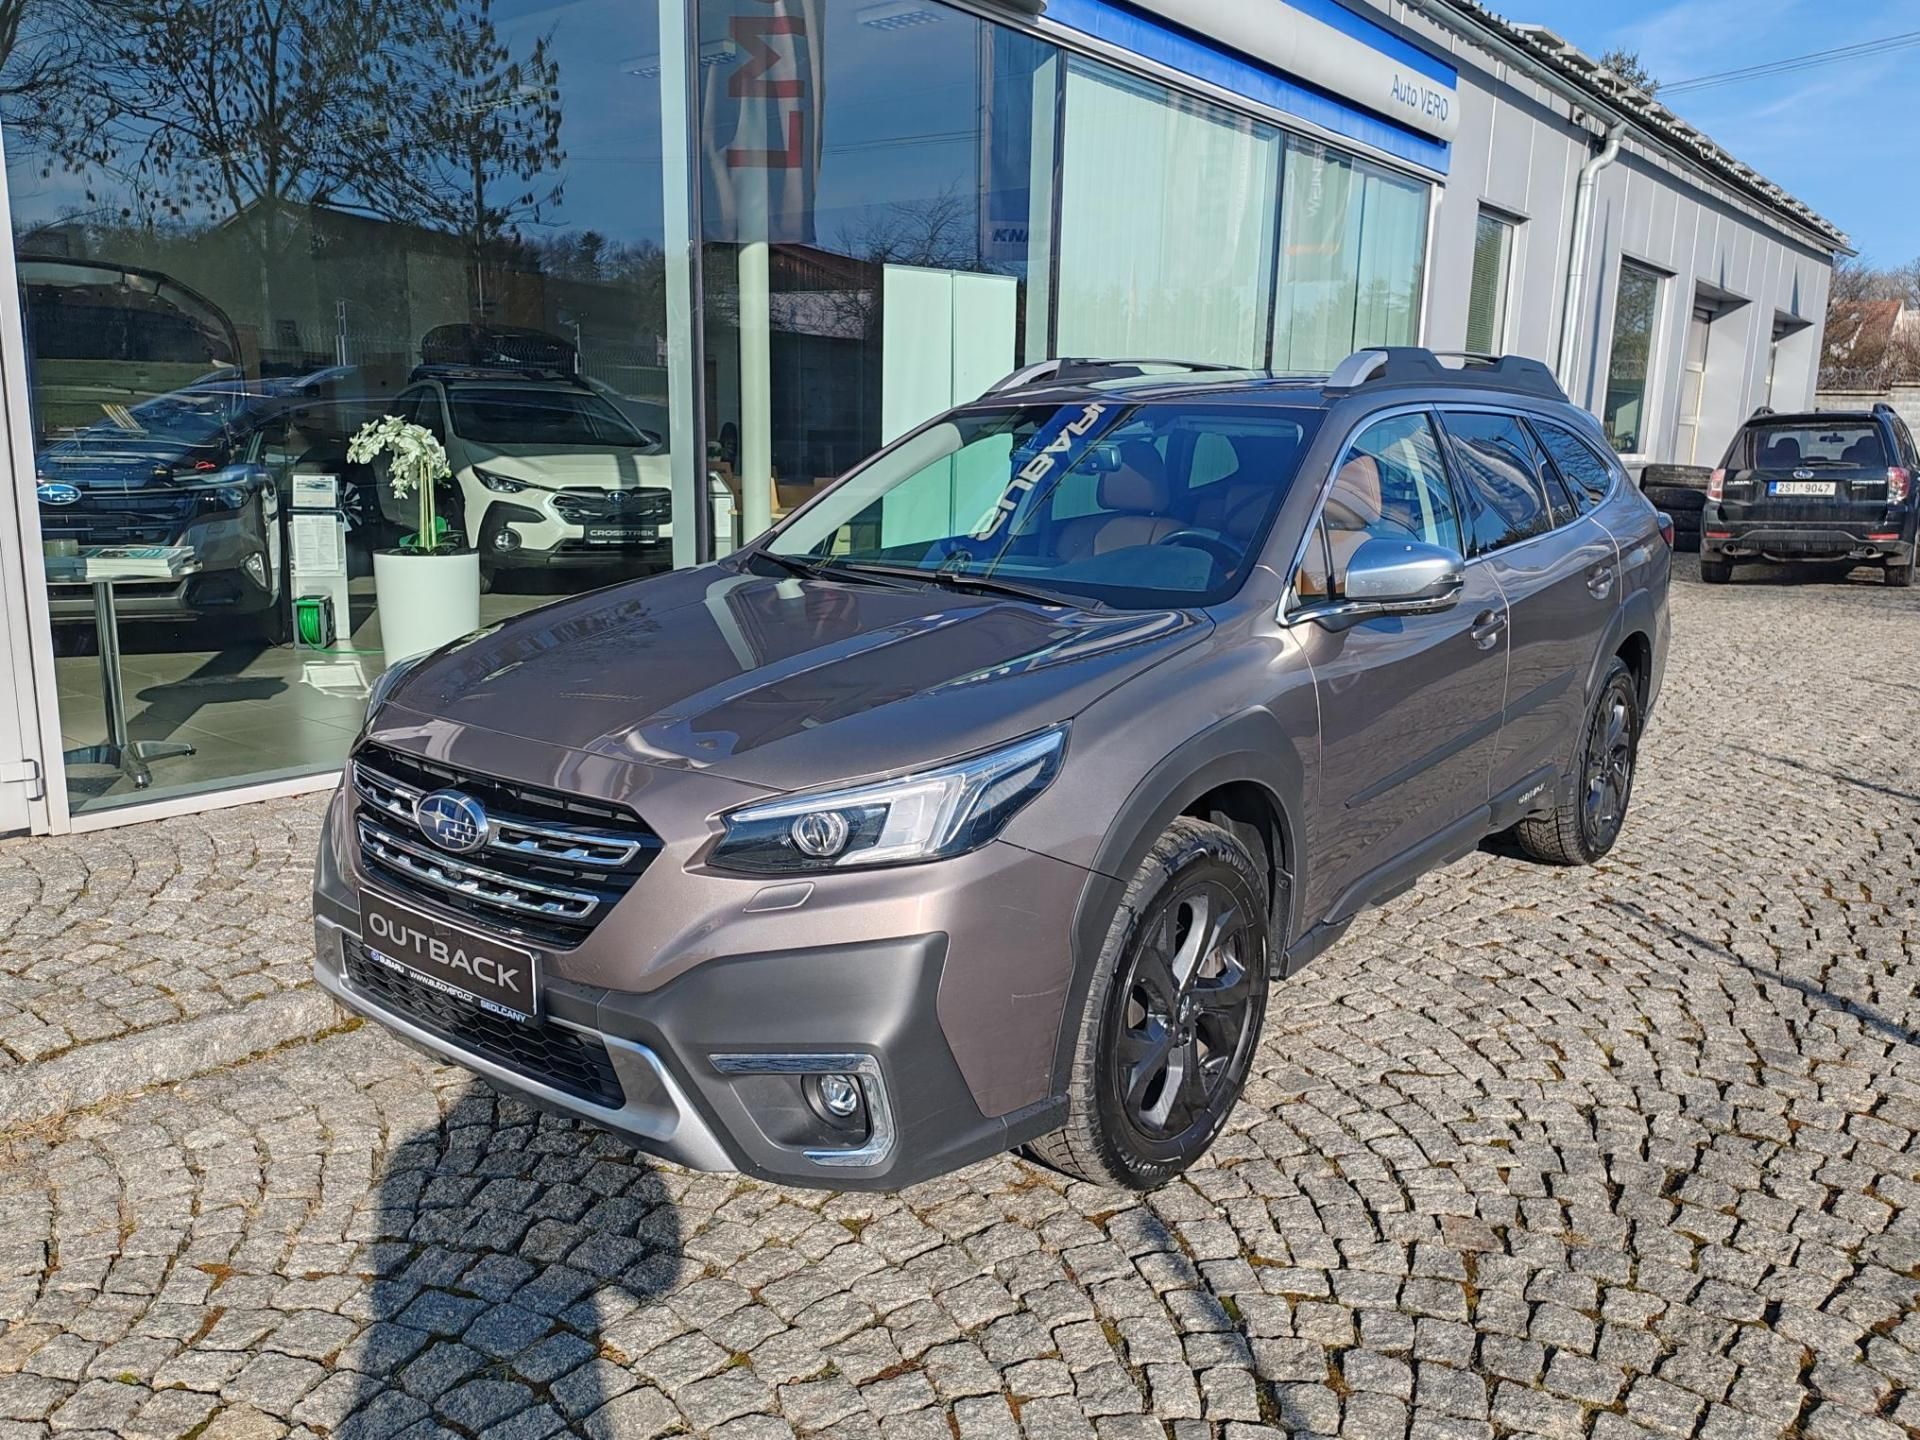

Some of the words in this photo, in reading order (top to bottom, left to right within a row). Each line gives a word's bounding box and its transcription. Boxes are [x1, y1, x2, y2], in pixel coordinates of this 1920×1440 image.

[1391, 74, 1417, 107] Auto
[1420, 87, 1449, 121] VERO
[1805, 483, 1830, 493] 9047
[589, 529, 655, 537] CROSSTREK
[368, 912, 521, 993] OUTBACK
[379, 954, 405, 974] SUBARU
